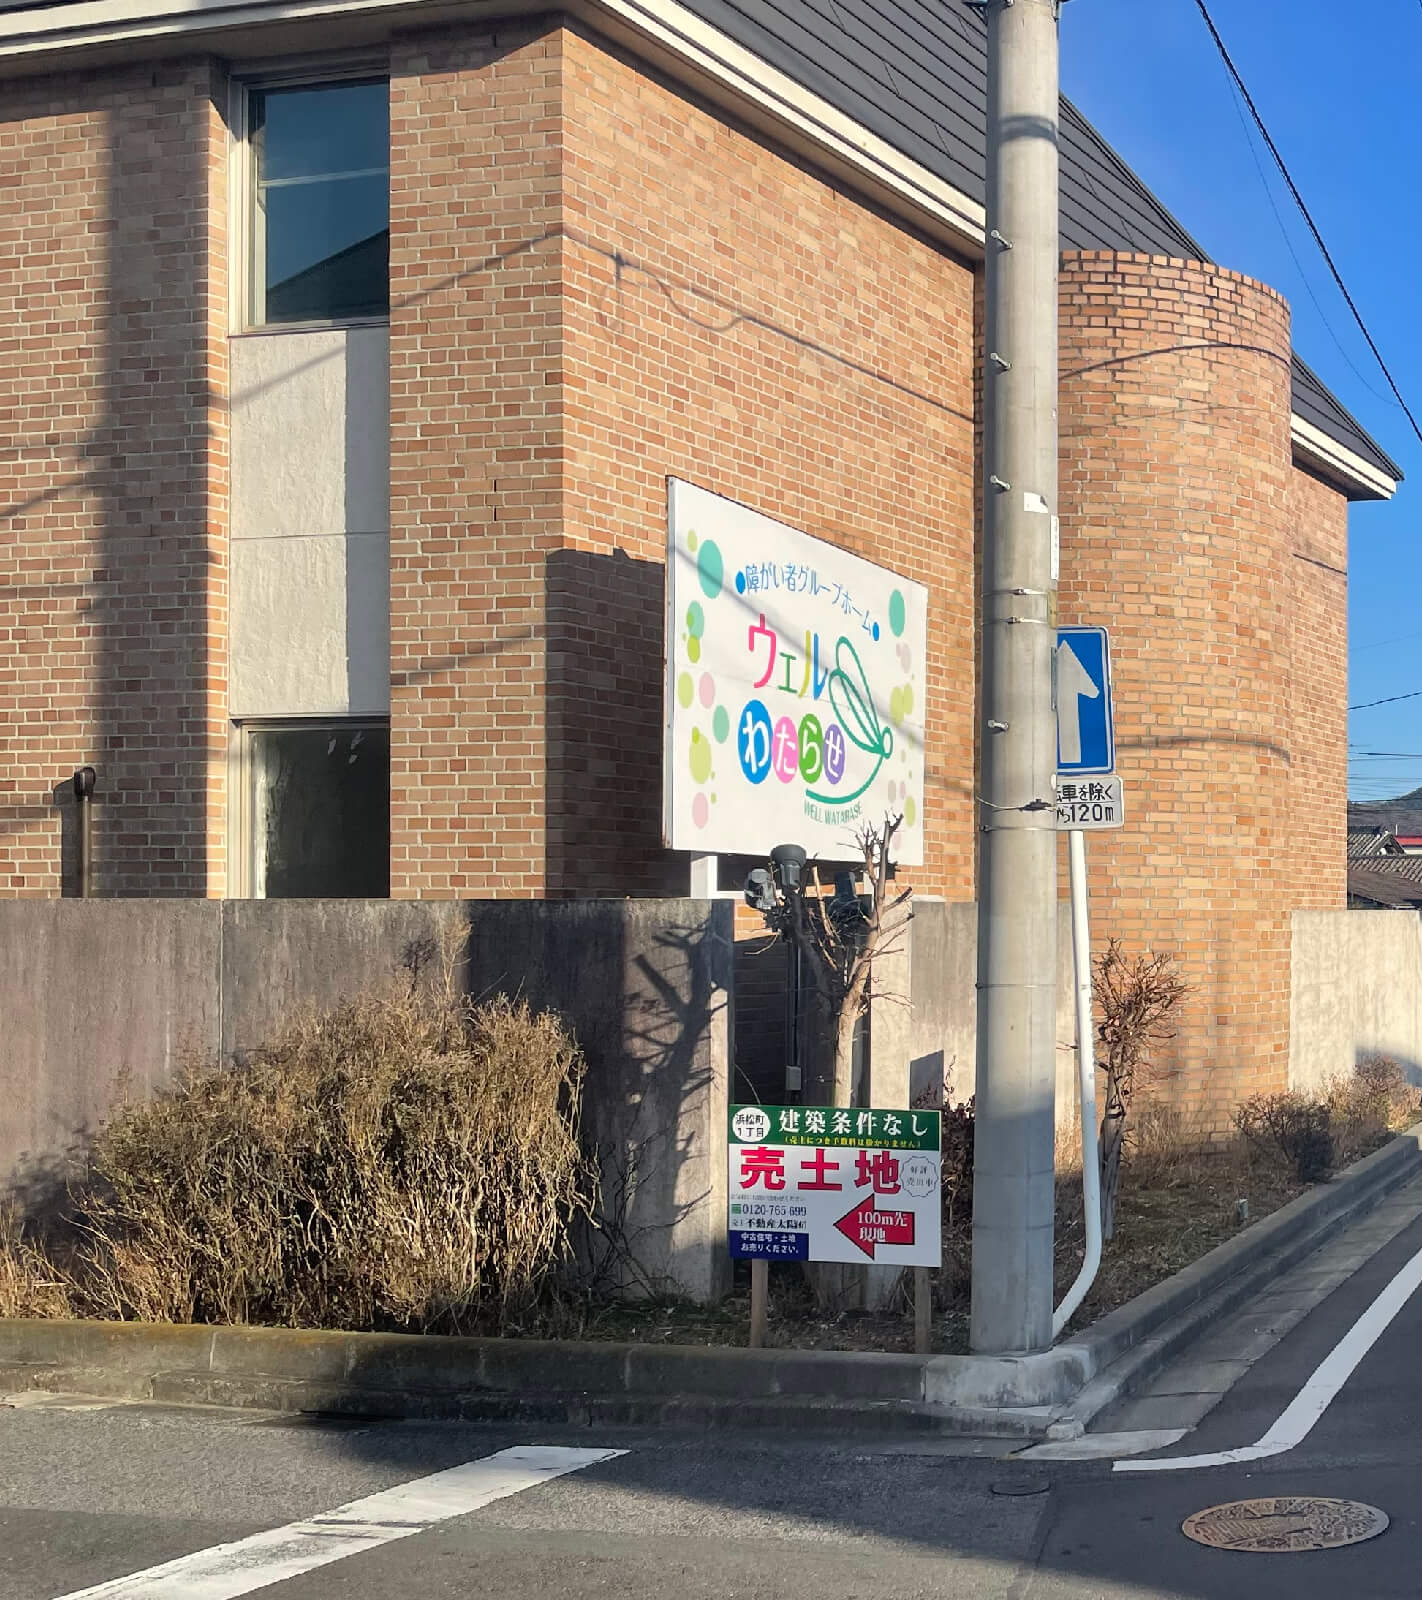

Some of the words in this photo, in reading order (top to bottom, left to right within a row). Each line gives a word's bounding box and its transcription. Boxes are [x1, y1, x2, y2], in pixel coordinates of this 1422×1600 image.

[745, 562, 872, 636] 障がい者グループホーム
[742, 711, 843, 778] わたらせ
[804, 799, 823, 823] WELL
[779, 1109, 929, 1137] 建築条件なし
[739, 1146, 901, 1195] 売土地
[859, 1226, 886, 1242] 現地
